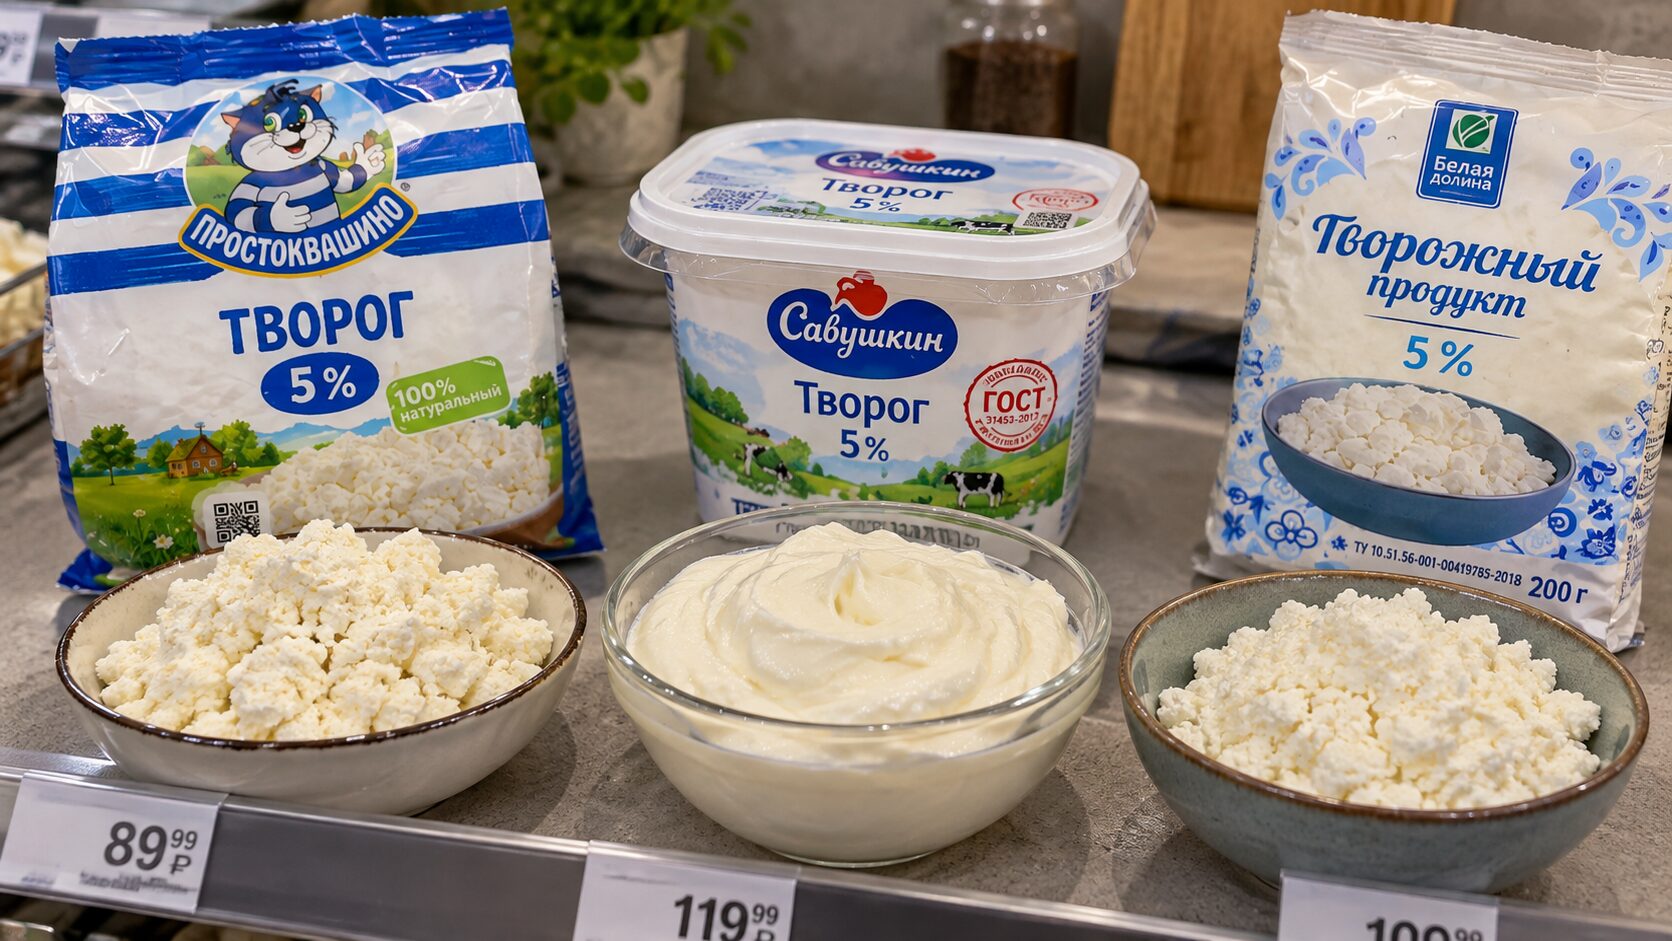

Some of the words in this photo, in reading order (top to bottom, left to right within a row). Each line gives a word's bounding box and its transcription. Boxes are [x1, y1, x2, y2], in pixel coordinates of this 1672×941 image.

[822, 177, 953, 200] Творог
[828, 153, 981, 178] Савушкин
[1429, 173, 1492, 191] долина
[1433, 155, 1494, 178] Белая
[190, 195, 404, 267] ПРОСТОКВАШИНО
[1312, 214, 1603, 293] Творожный
[1366, 273, 1526, 319] продукт
[219, 290, 414, 355] ТВОРОГ
[779, 301, 944, 359] Савушкин
[394, 377, 456, 408] 100%
[400, 383, 502, 423] натуральный
[794, 379, 930, 429] Творог
[983, 386, 1046, 413] ГОСТ
[1354, 541, 1369, 555] ТУ
[1371, 545, 1523, 587] 10.51.56-001-00419785-2018
[1528, 575, 1572, 603] 200
[1576, 586, 1588, 604] г
[104, 821, 167, 871] 89
[171, 829, 198, 850] 99
[674, 894, 748, 941] 119
[752, 903, 779, 926] 99
